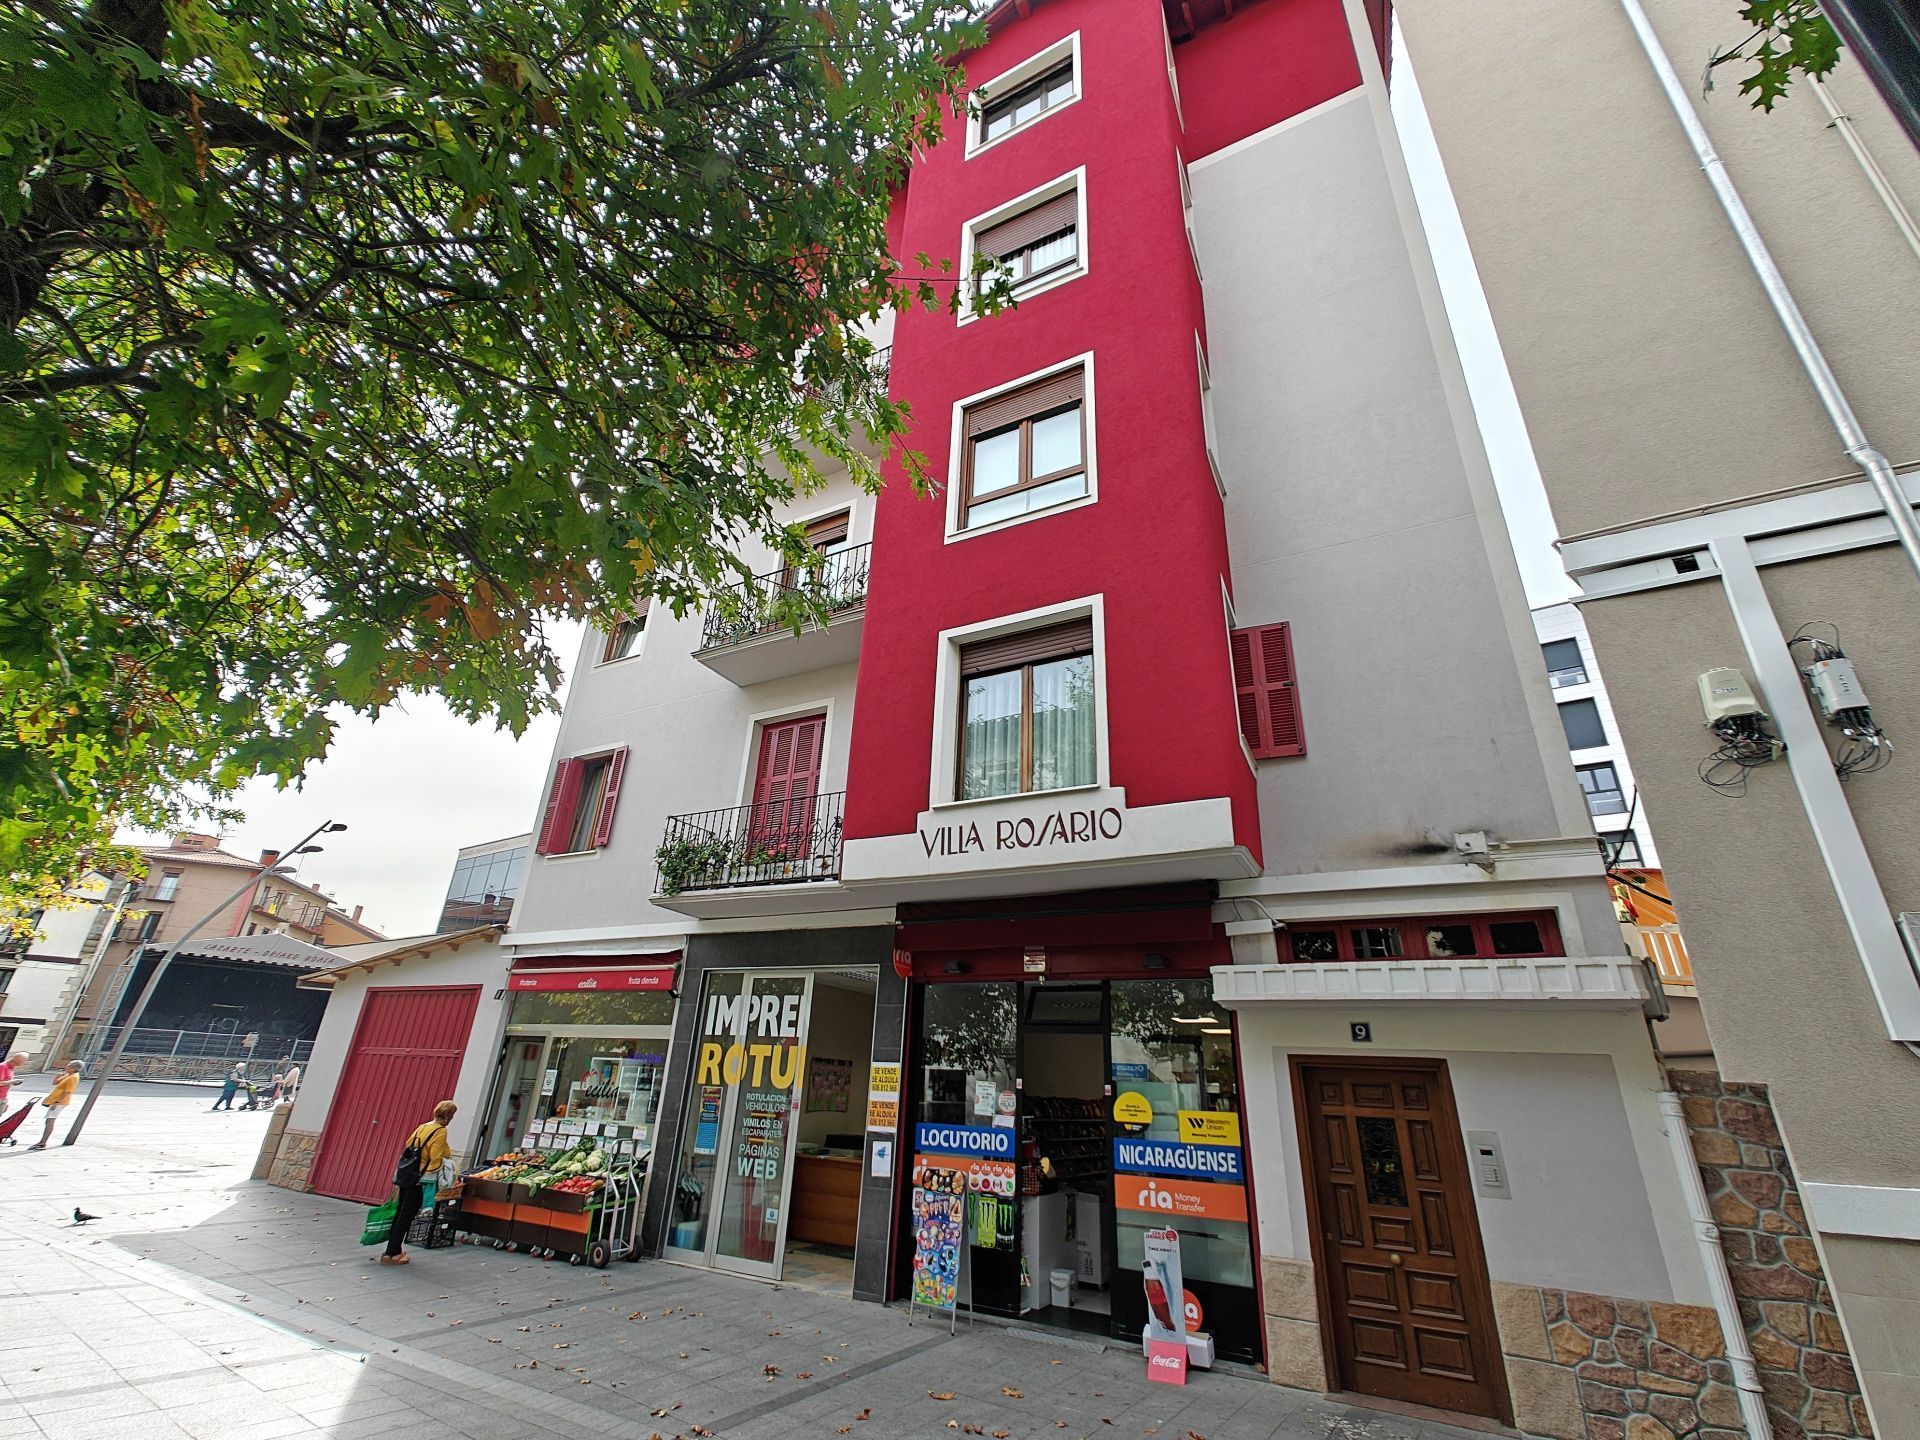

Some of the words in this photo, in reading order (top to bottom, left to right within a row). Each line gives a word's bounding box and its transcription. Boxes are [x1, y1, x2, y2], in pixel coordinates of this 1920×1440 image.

[920, 821, 984, 858] VILLA
[996, 807, 1122, 850] ROSARIO
[204, 944, 251, 954] LASARTE
[1355, 1025, 1366, 1040] 9
[881, 1067, 897, 1075] VENDE
[879, 1076, 898, 1084] ALQUILA
[879, 1101, 895, 1109] VENDE
[876, 1110, 896, 1118] ALQUILA
[743, 1117, 771, 1128] VINILOS
[773, 1119, 784, 1129] EN
[741, 1128, 782, 1138] ESCAPARATES
[921, 1128, 1008, 1152] LOCUTORIO
[1119, 1144, 1238, 1173] NICARAGÜENSE
[737, 1157, 778, 1180] WEB
[1138, 1182, 1173, 1209] ria
[1174, 1192, 1201, 1204] Money
[1175, 1202, 1206, 1213] Transfer
